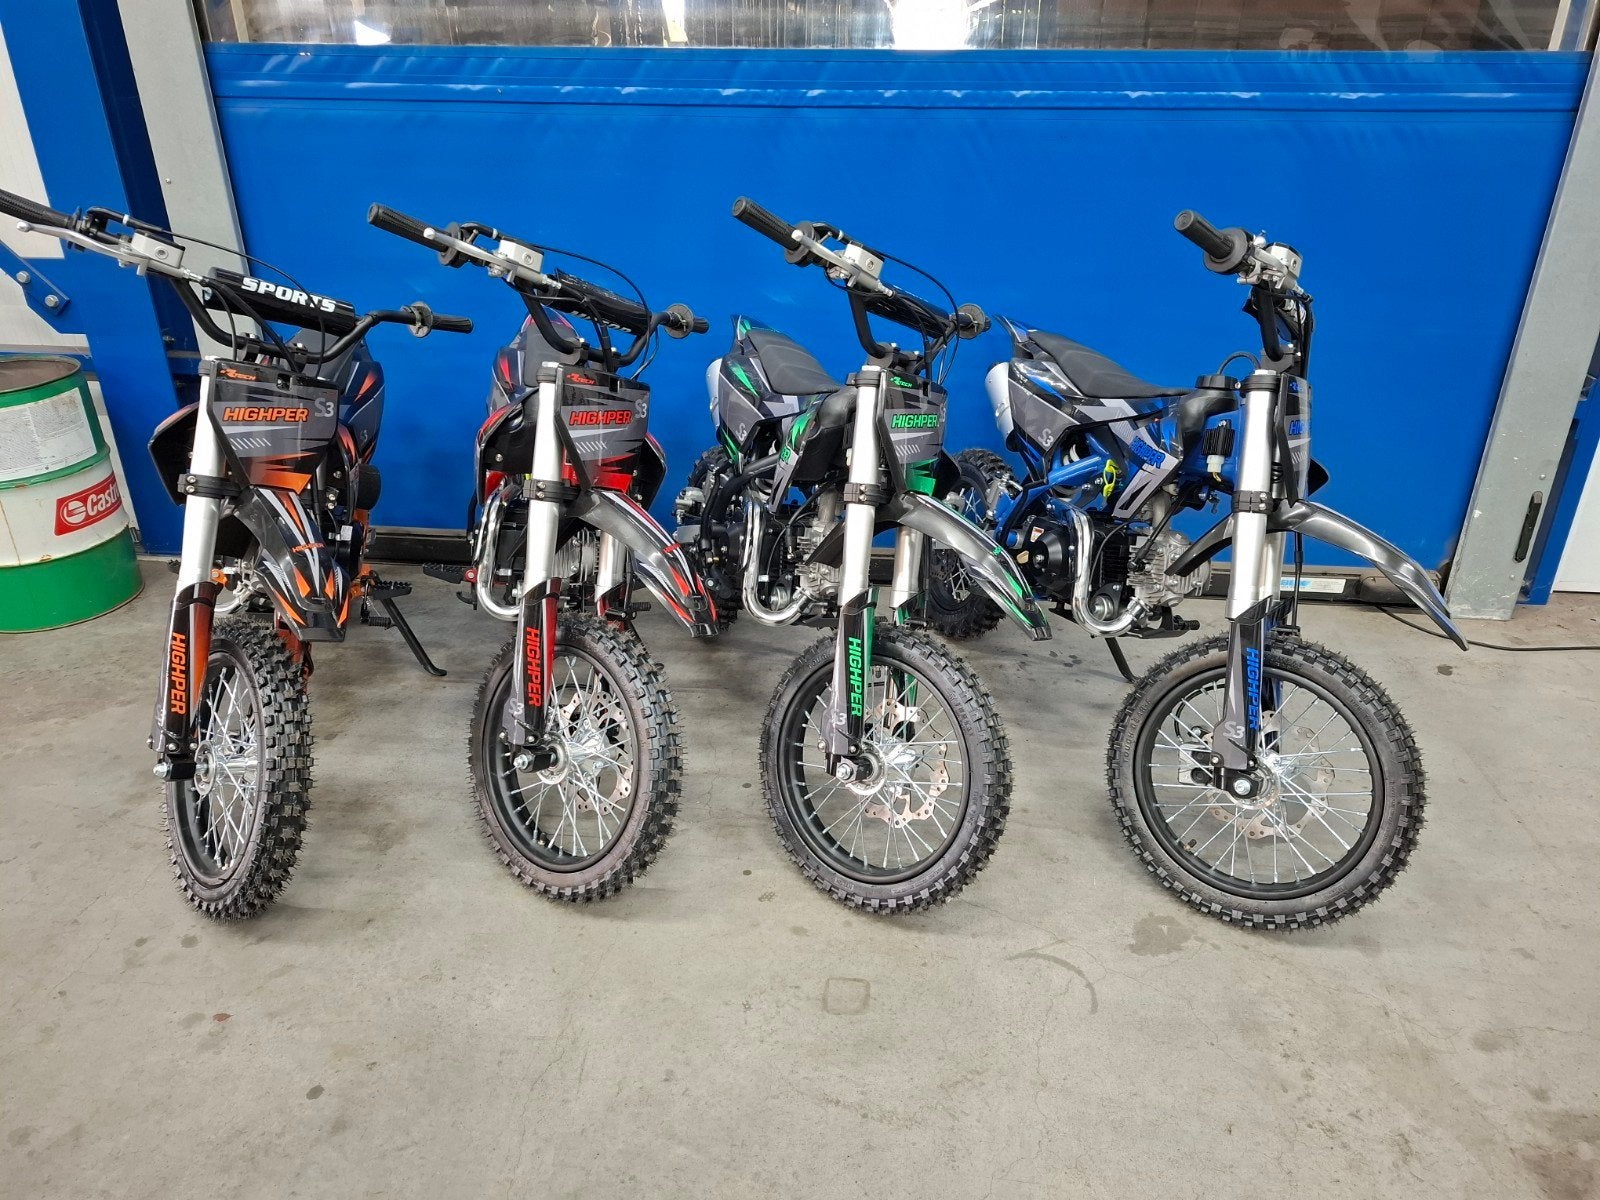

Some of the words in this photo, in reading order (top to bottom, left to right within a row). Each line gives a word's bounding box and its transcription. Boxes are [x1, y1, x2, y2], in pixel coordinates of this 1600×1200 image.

[241, 276, 337, 313] SPORTS
[223, 406, 310, 422] HIGHPER
[314, 397, 335, 418] S3
[635, 399, 648, 419] S3
[569, 410, 633, 426] HIGHPER
[891, 413, 940, 429] HIGHPER
[1038, 428, 1054, 448] S3
[170, 632, 186, 715] HIGHPER
[526, 627, 543, 707] HIGHPER
[848, 636, 863, 717] HIGHPER
[1246, 647, 1260, 730] HIGHPER
[1223, 721, 1245, 739] S3
